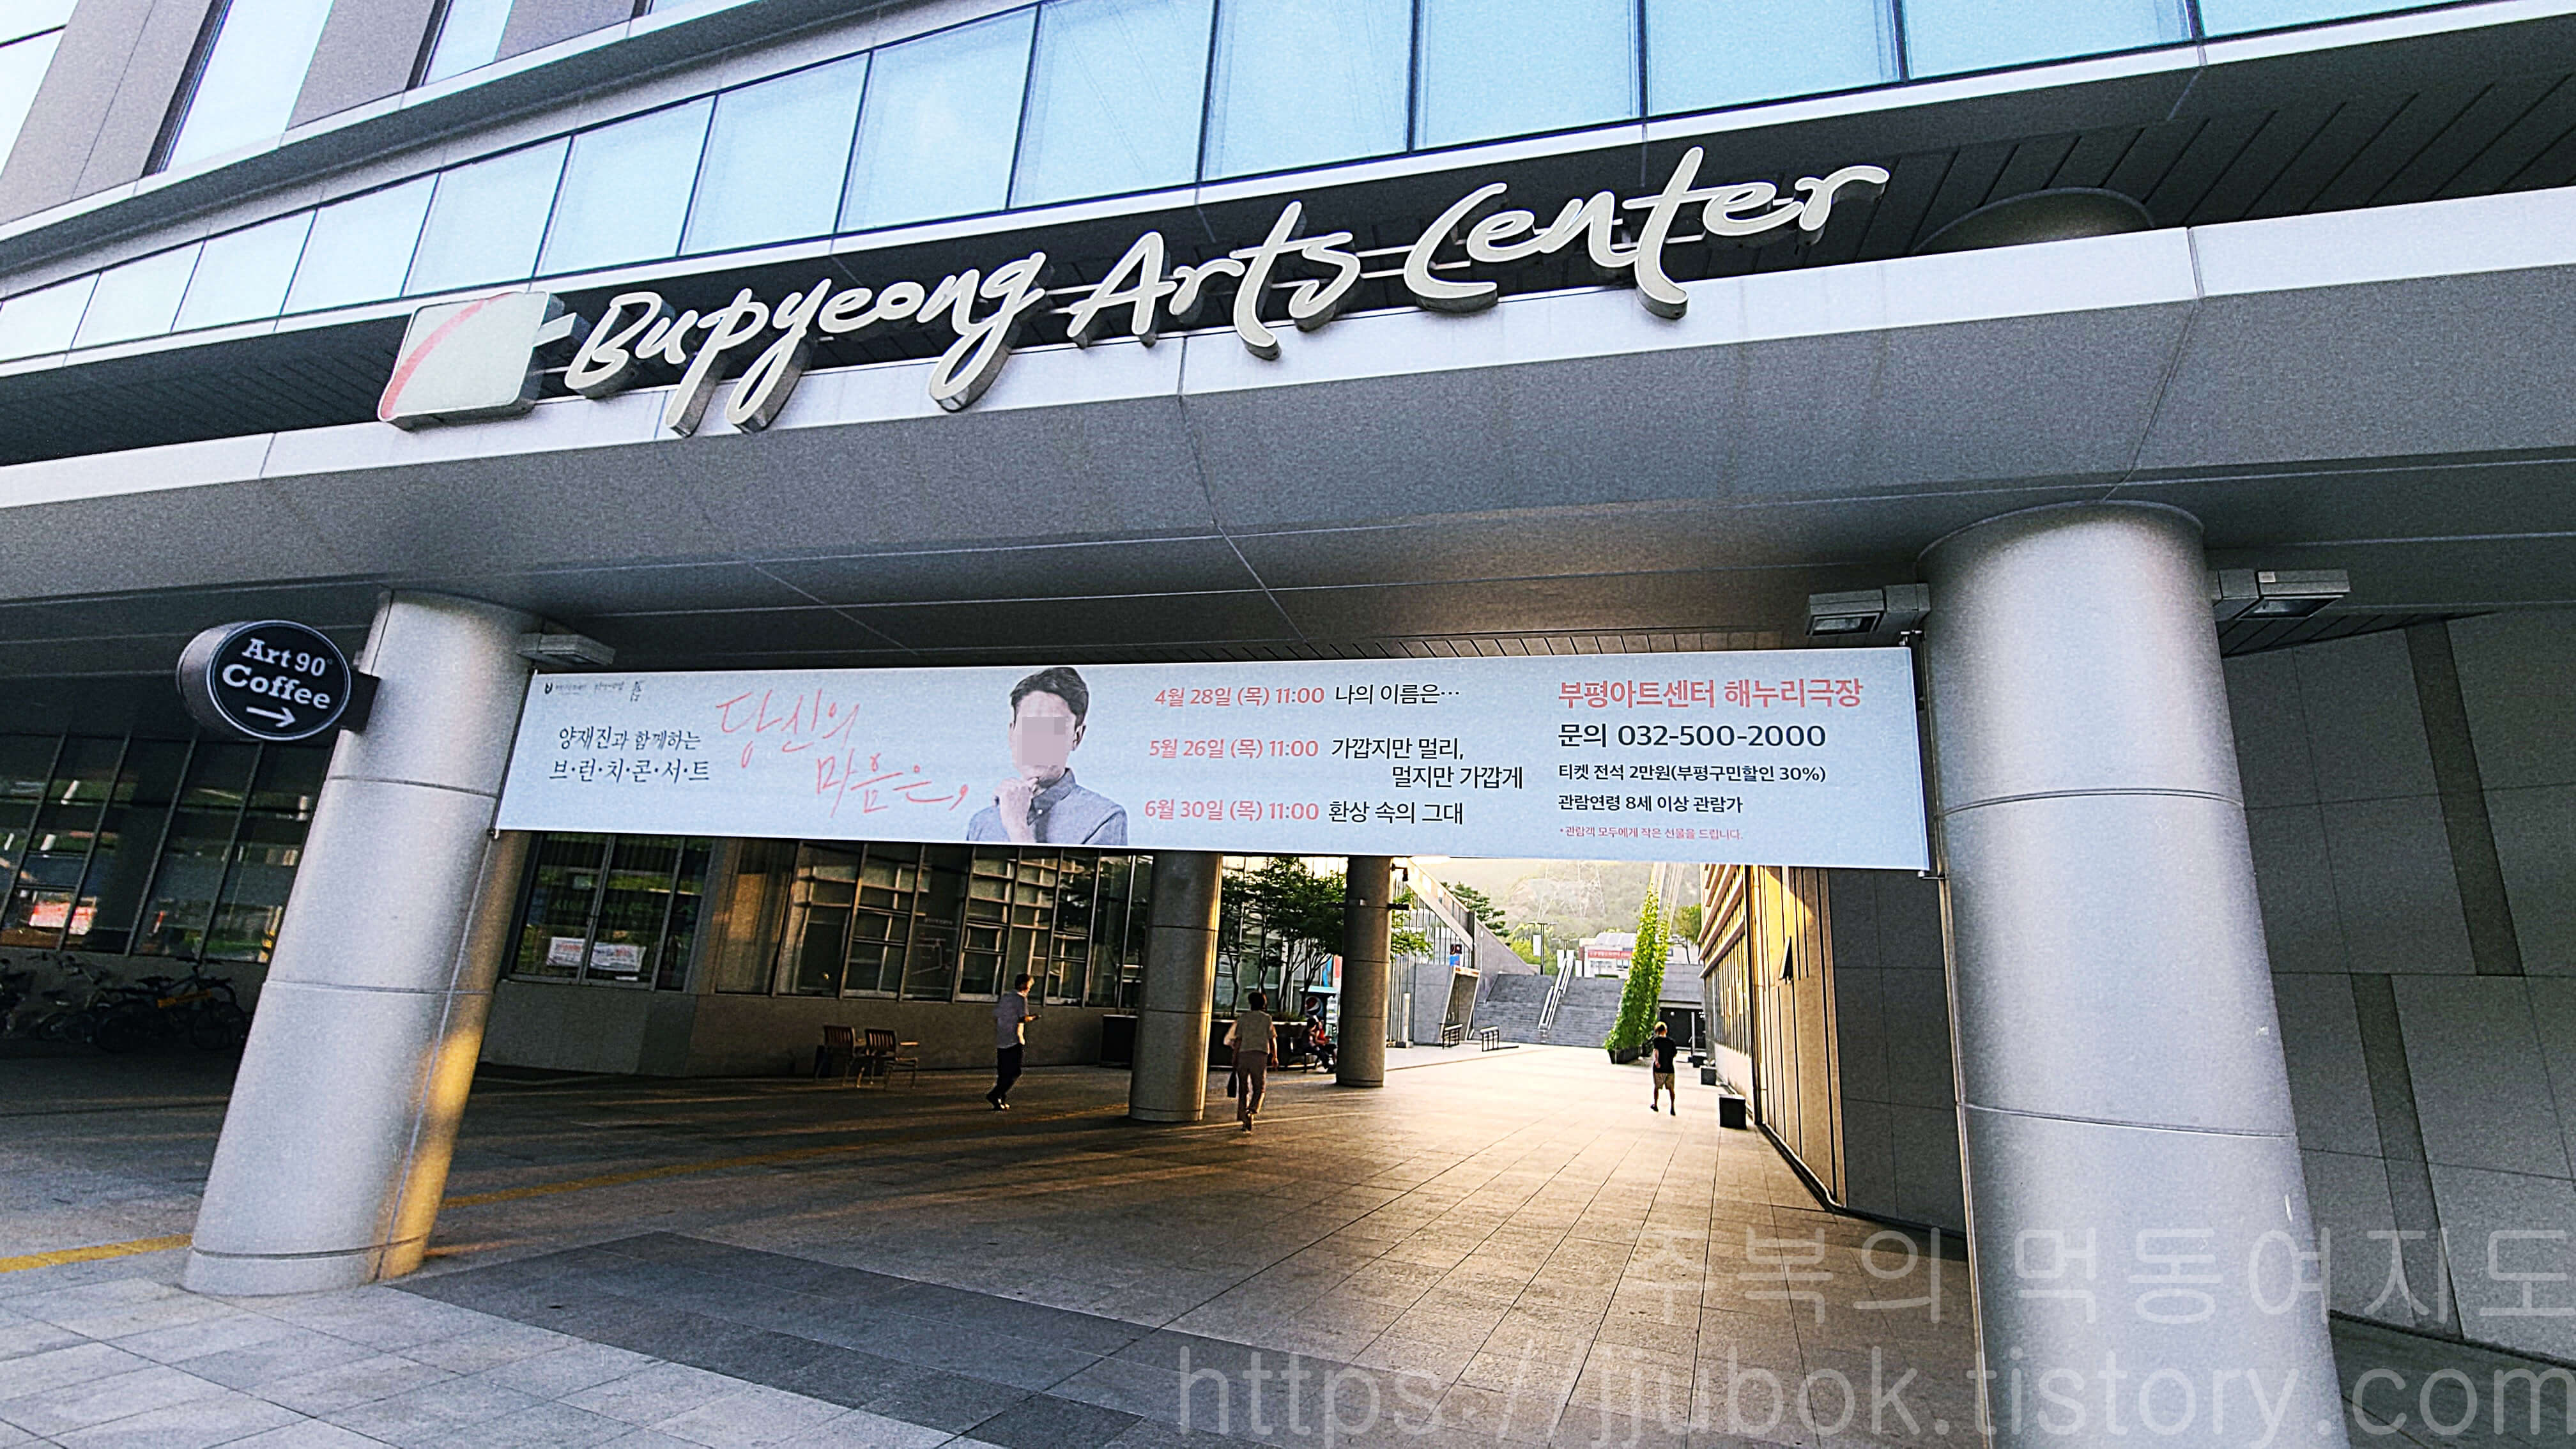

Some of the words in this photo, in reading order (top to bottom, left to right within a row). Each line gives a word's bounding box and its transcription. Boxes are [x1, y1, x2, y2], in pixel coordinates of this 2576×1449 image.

[565, 252, 1046, 437] Bupyeong
[1068, 200, 1363, 358] Arts
[1406, 146, 1889, 316] Center
[241, 638, 293, 667] Art
[222, 663, 330, 710] Coffee
[1155, 687, 1184, 707] 4월
[1190, 687, 1230, 706] 28일
[1238, 687, 1269, 705] (목)
[1276, 688, 1324, 703] 11:00
[1336, 685, 1373, 705] 나의
[1559, 680, 1714, 708] 부평아트센터
[1724, 678, 1863, 707] 해누리극장
[560, 726, 628, 749] 양재진과
[636, 730, 700, 750] 함께하는
[716, 689, 860, 767] 당신의
[1558, 724, 1606, 747] 문의
[1618, 726, 1825, 746] 032-500-2000
[1150, 739, 1177, 758] 5월
[1183, 739, 1223, 758] 26일
[1231, 739, 1262, 758] (목)
[1269, 741, 1318, 756] 11:00
[1332, 738, 1413, 759] 가깝지만
[1419, 738, 1463, 760] 멀리,
[1393, 766, 1454, 788] 멀지만
[1460, 767, 1522, 789] 가깝게
[1560, 764, 1588, 779] 티켓
[1594, 765, 1623, 780] 전석
[1630, 765, 1774, 781] 2만원(부평구민할인
[1780, 767, 1825, 782] 30%)
[1146, 799, 1174, 819] 6월
[1181, 800, 1223, 820] 30일
[1230, 801, 1262, 821] (목)
[1269, 803, 1319, 820] 11:00
[1329, 801, 1370, 822] 환상
[1375, 802, 1414, 824] 속의
[1422, 802, 1462, 824] 그대
[1559, 795, 1620, 811] 관람연령
[1626, 796, 1652, 811] 8세
[1657, 796, 1689, 812] 이상
[1694, 797, 1743, 813] 관람가
[1599, 828, 1637, 838] 모두에게
[1641, 828, 1661, 838] 작은
[1699, 829, 1743, 839] 드립니다.
